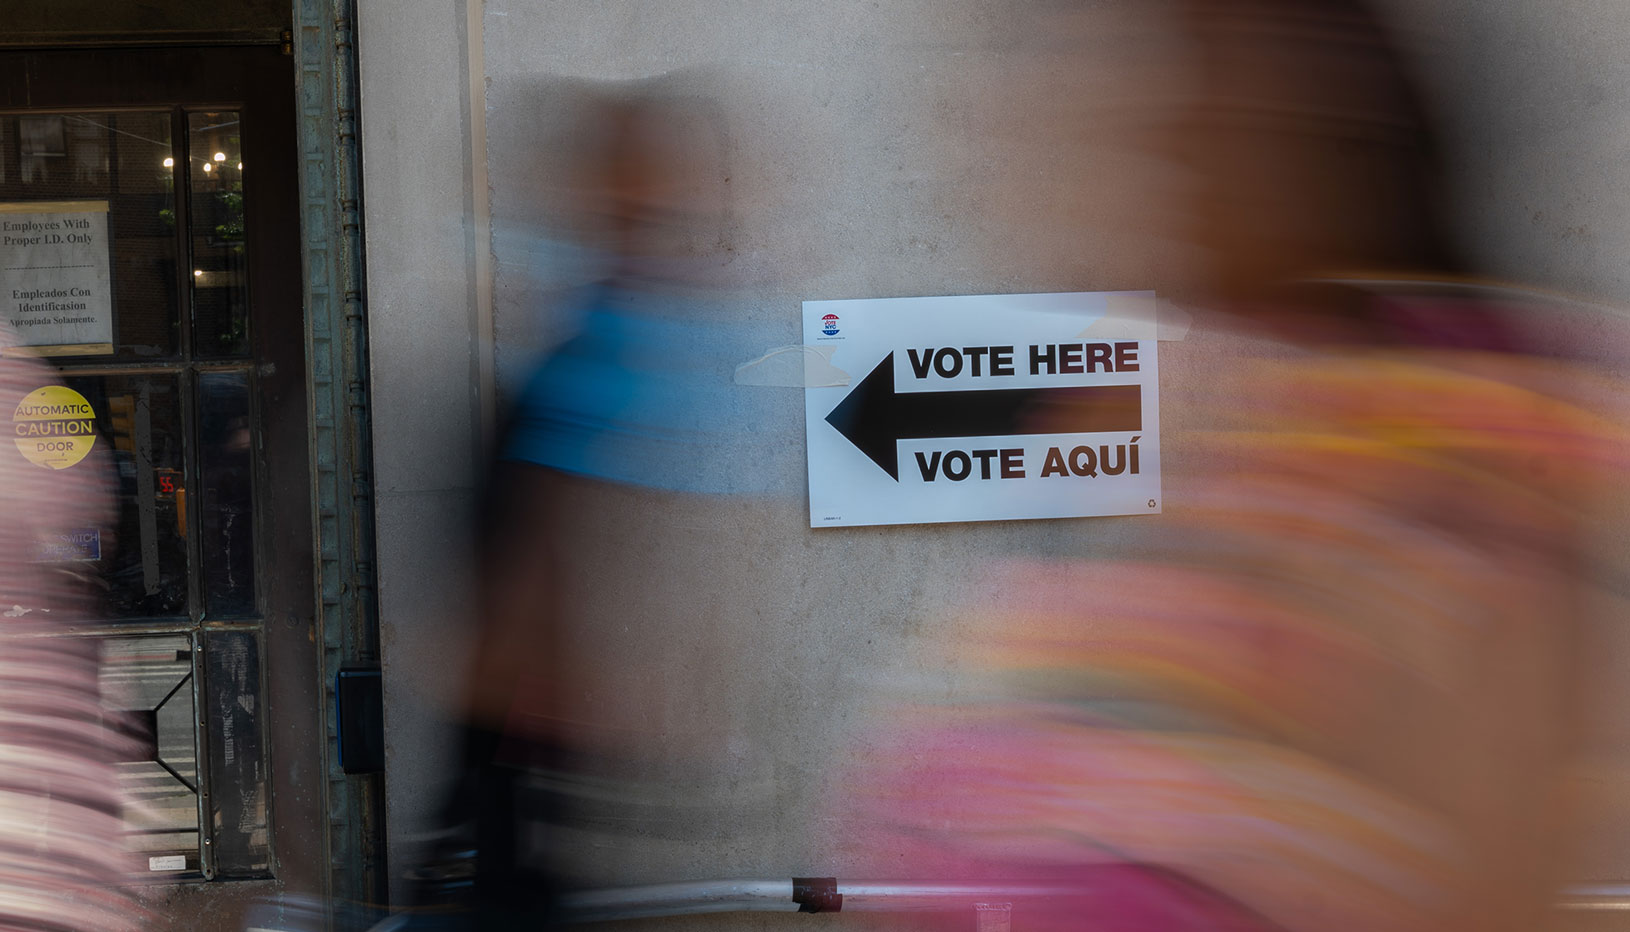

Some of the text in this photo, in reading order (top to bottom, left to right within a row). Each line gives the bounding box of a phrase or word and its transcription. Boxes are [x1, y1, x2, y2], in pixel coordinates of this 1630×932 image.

[3, 219, 90, 232] Employees With
[4, 233, 92, 247] Proper I.D. Only
[12, 287, 91, 300] Empleados Con
[19, 301, 86, 312] Identificasion
[53, 316, 97, 325] Solamente.
[907, 342, 1140, 379] VOTE HERE
[16, 404, 89, 416] AUTOMATIC
[15, 420, 92, 436] CAUTION
[37, 441, 73, 452] DOOR
[915, 436, 1141, 482] VOTE AQUÍ
